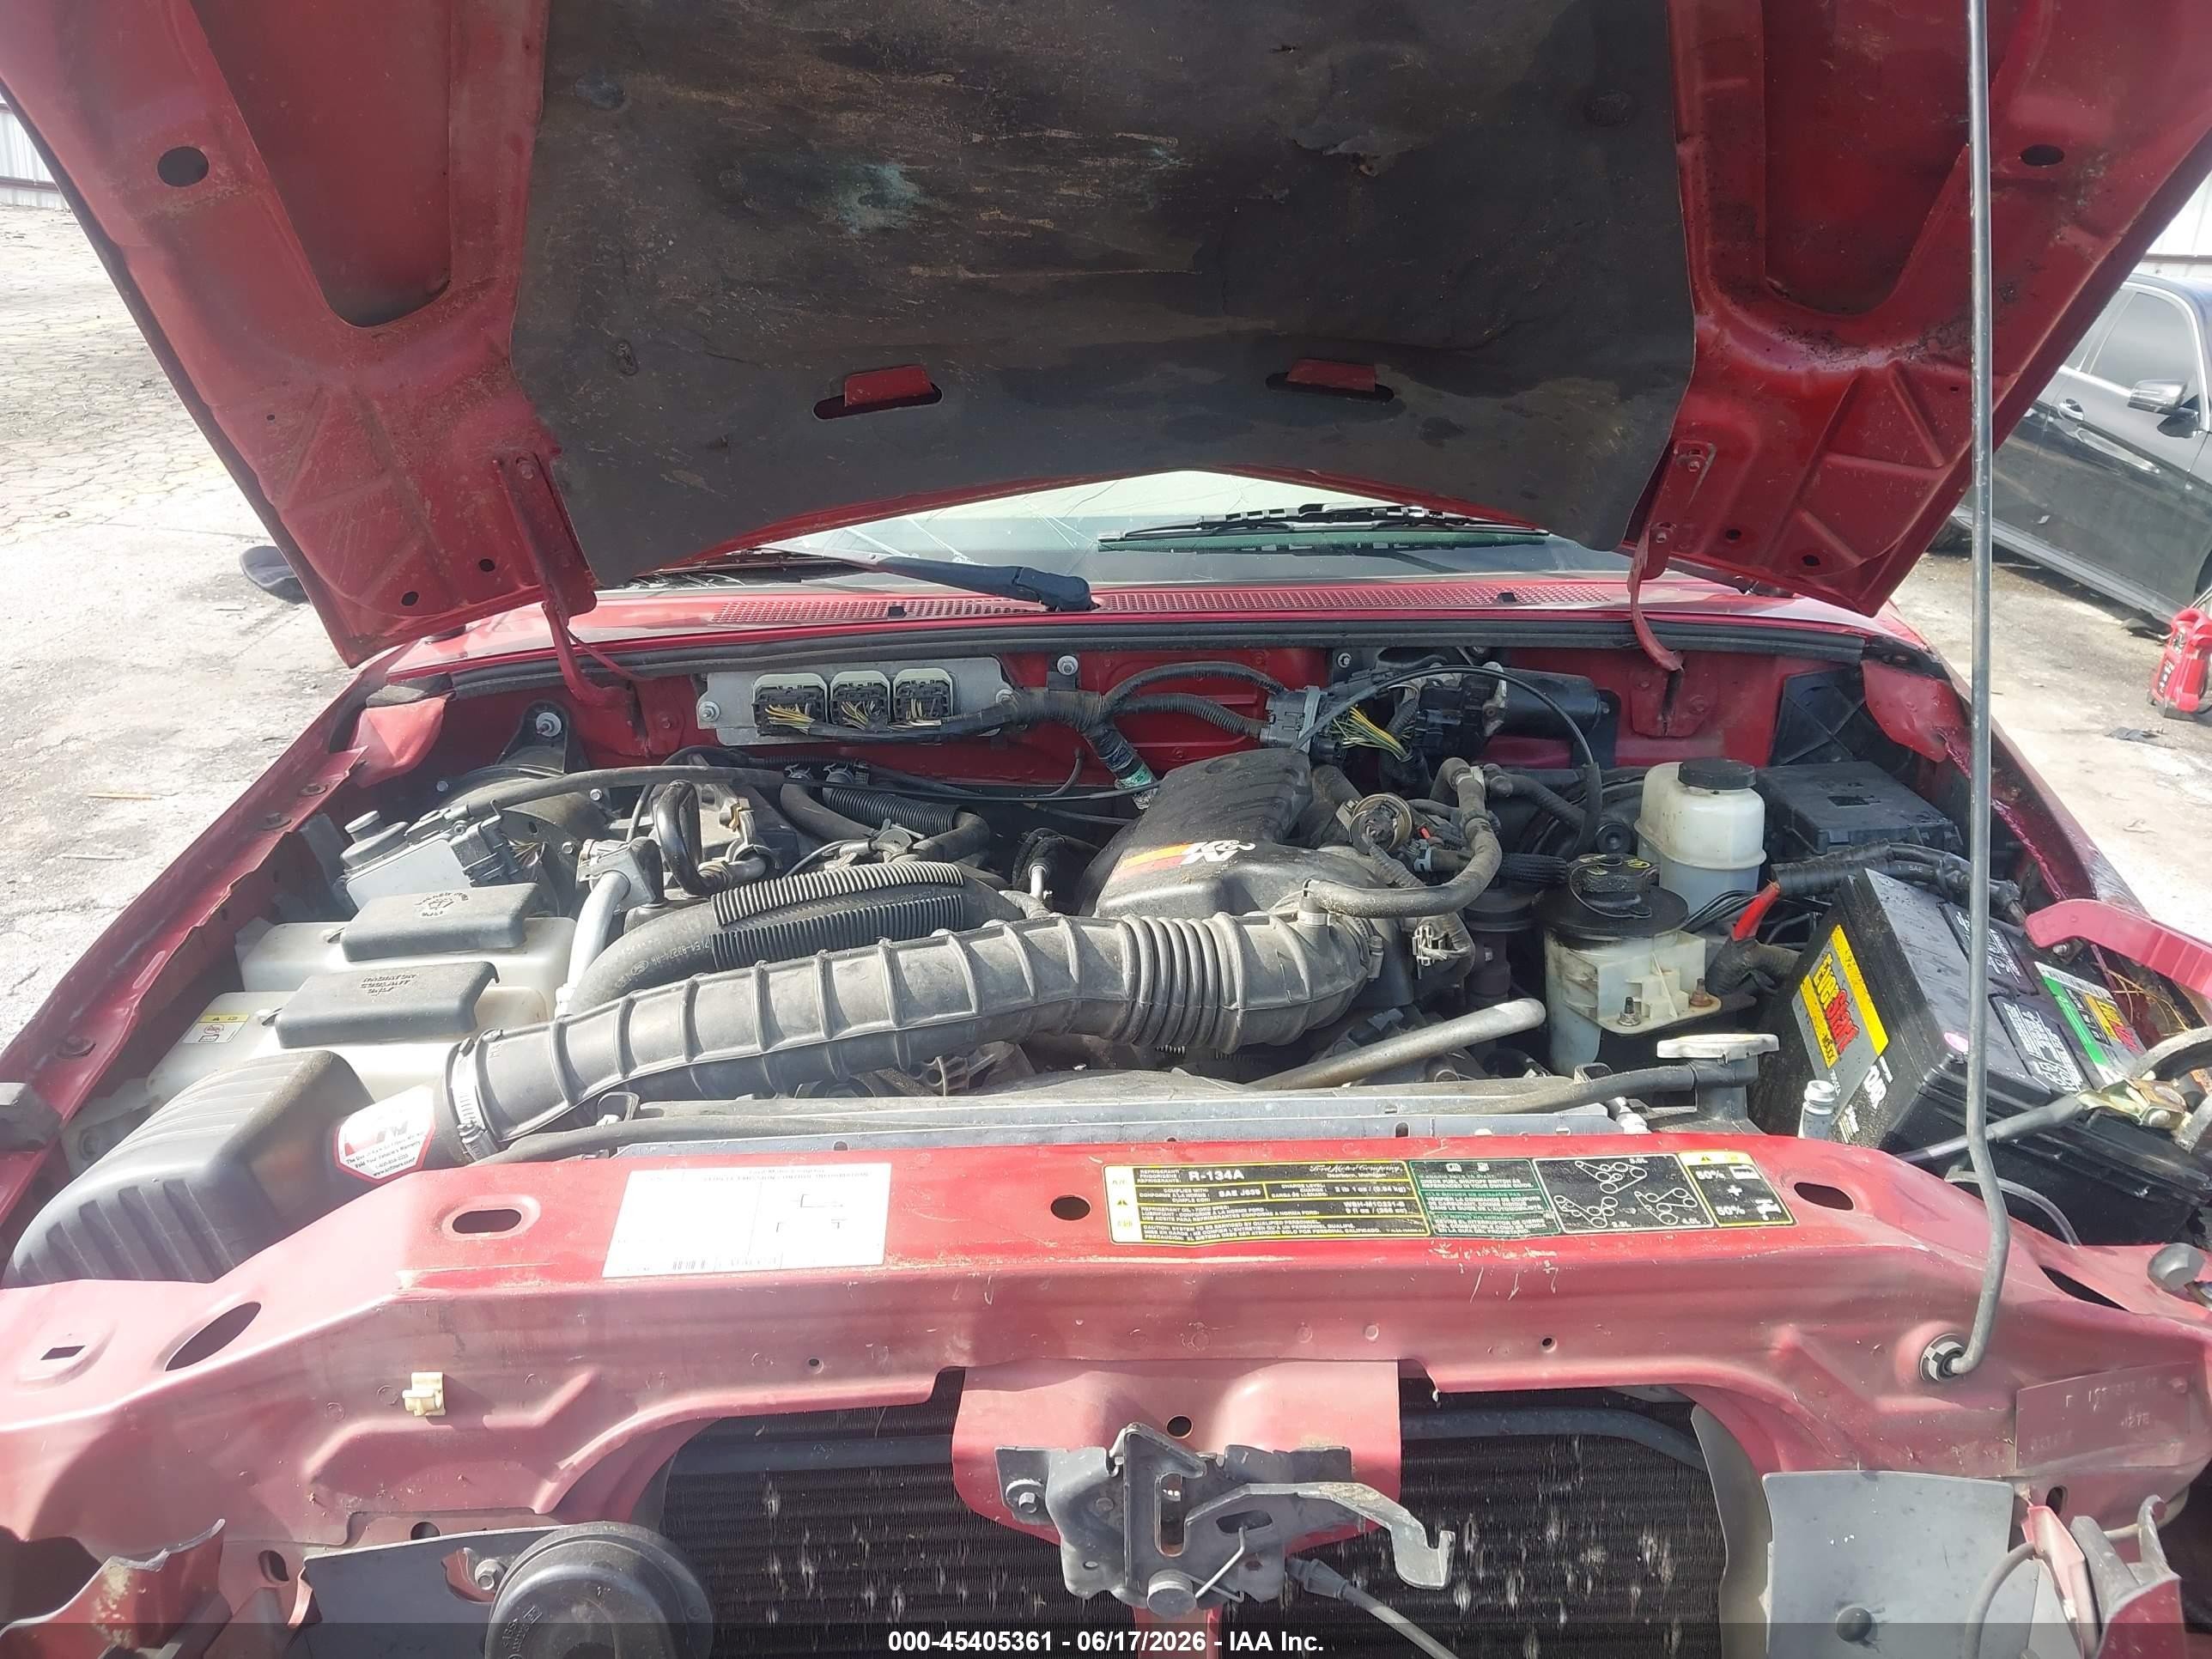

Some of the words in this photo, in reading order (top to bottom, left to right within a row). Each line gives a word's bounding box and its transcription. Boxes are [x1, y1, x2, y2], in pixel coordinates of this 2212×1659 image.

[1813, 952, 1860, 1055] EverStart
[1188, 1169, 1245, 1182] R-134A
[1695, 1170, 1726, 1181] 50%
[1218, 1189, 1237, 1198] SAE
[1717, 1205, 1746, 1216] 50%
